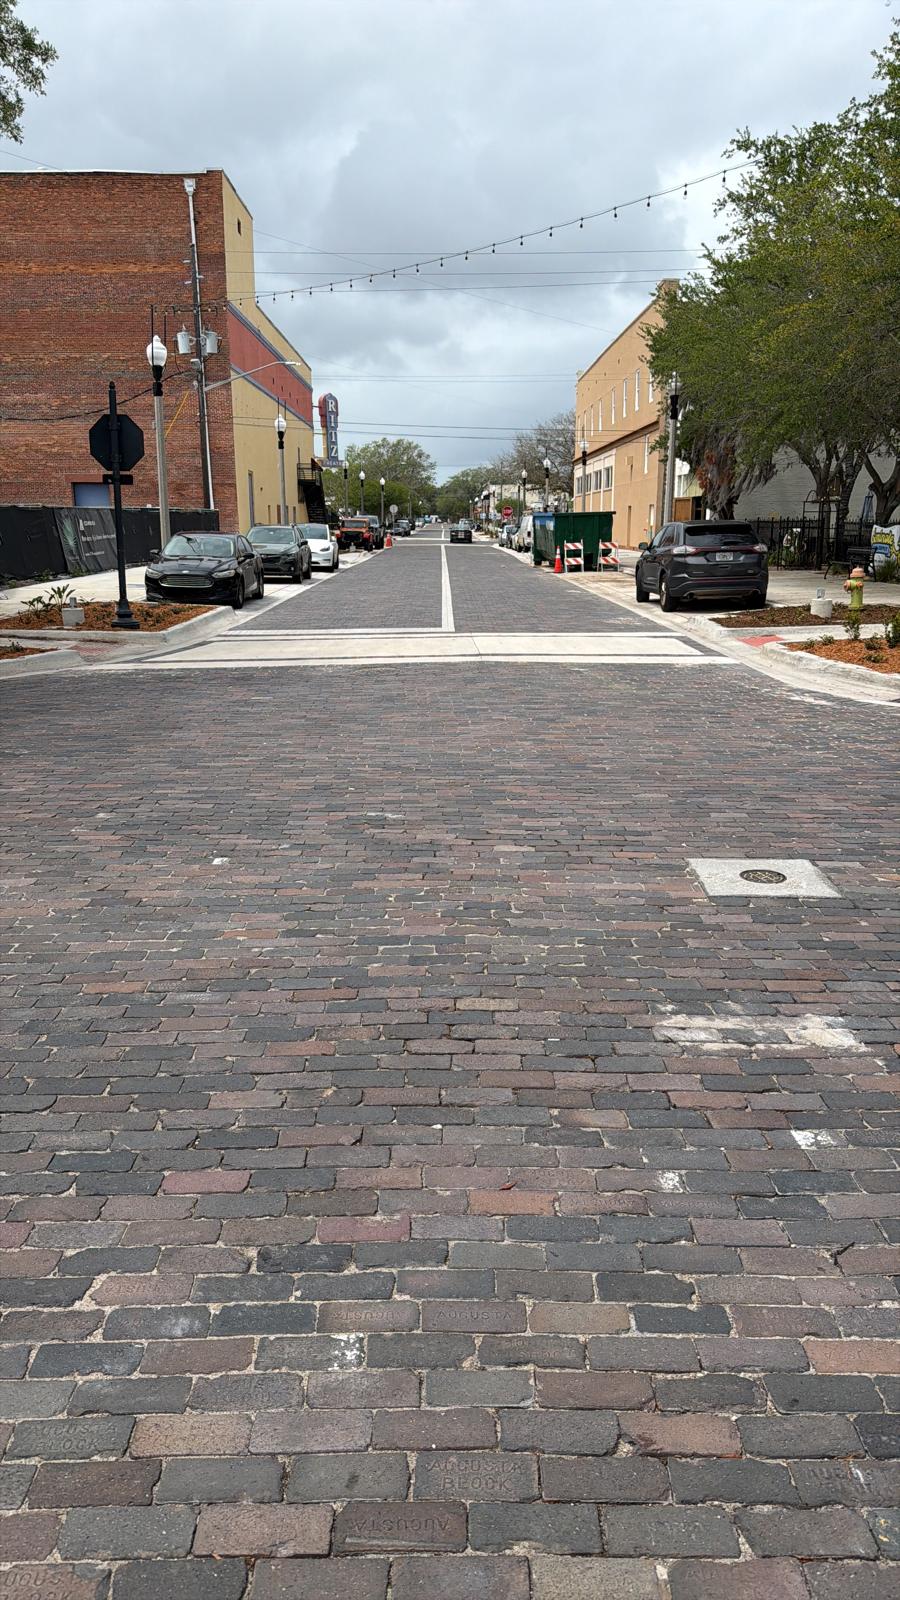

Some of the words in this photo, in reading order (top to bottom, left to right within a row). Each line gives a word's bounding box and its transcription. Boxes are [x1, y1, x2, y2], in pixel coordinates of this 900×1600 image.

[327, 399, 338, 457] RITZ
[436, 1310, 512, 1320] AUGUSTA
[427, 1458, 523, 1474] AUGUSTA
[440, 1476, 513, 1491] BLOCK
[352, 1516, 450, 1532] AUGUSTA
